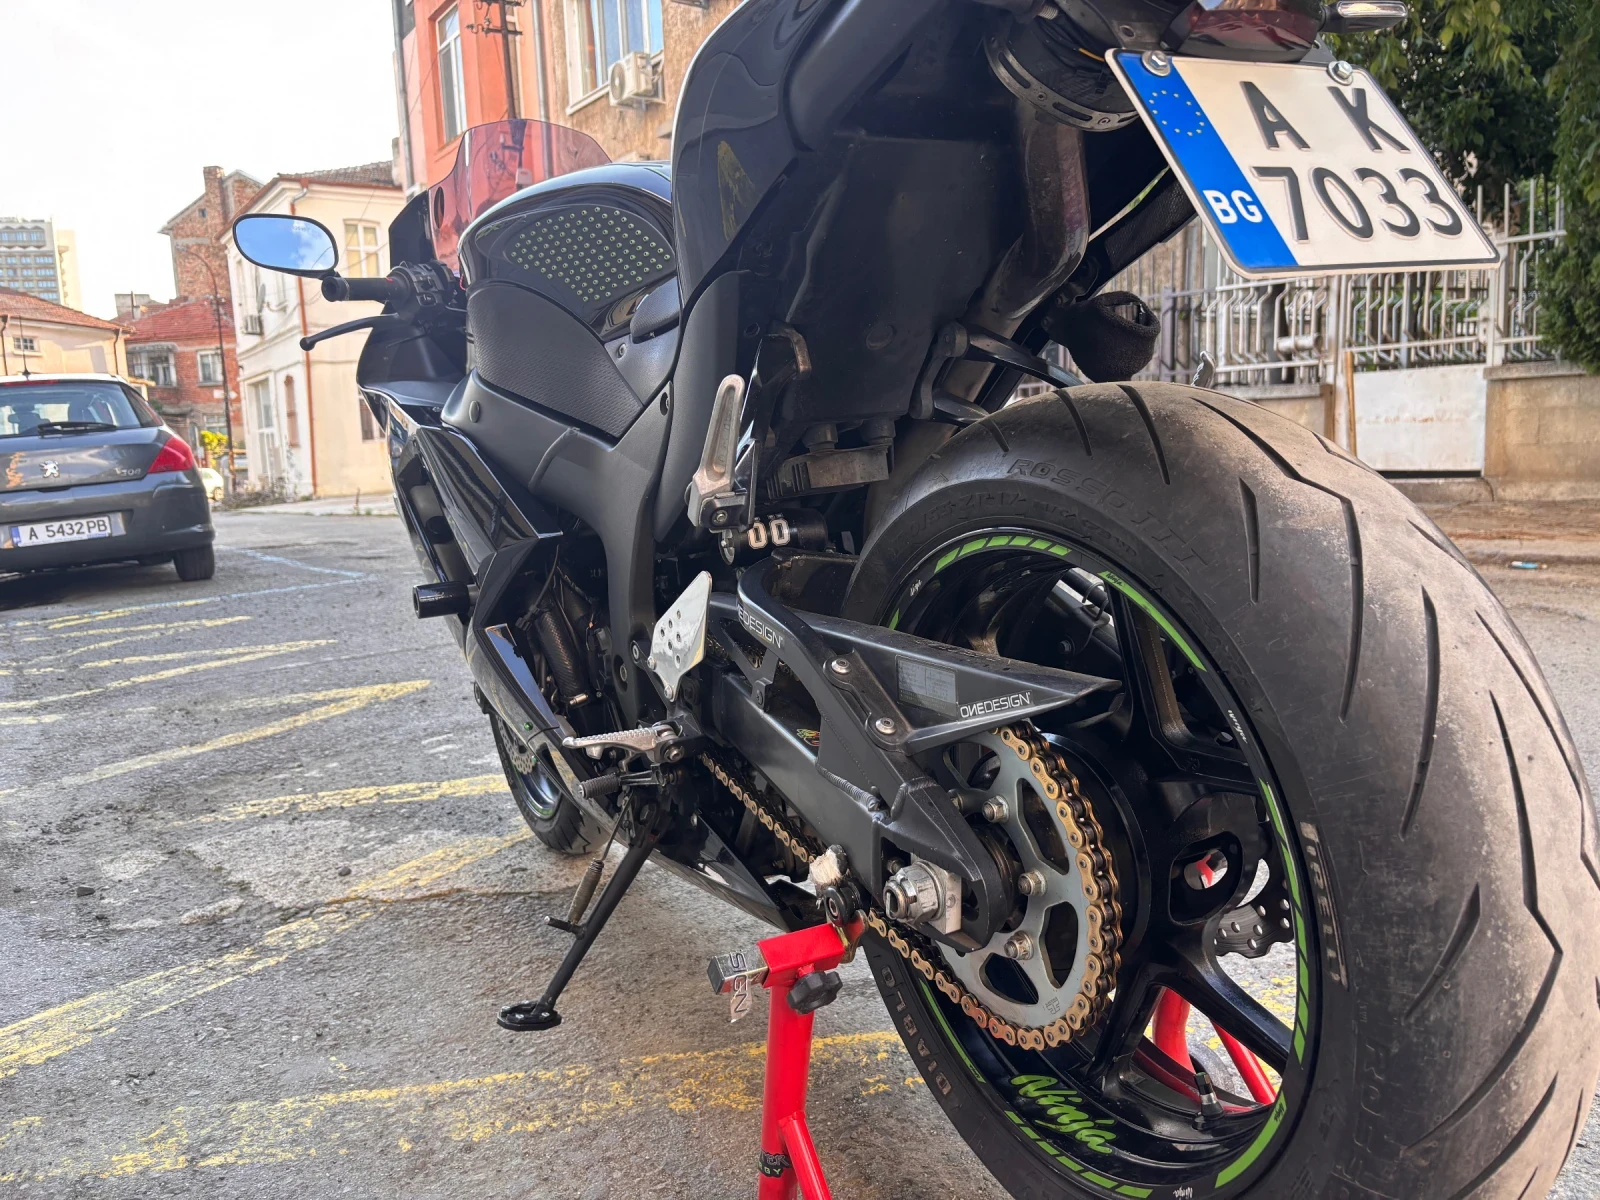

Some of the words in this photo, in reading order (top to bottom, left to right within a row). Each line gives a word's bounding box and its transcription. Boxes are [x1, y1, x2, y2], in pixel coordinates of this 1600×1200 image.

[1239, 80, 1311, 151] A
[1326, 85, 1411, 153] K
[1202, 188, 1264, 224] BG
[1251, 165, 1464, 243] 7033
[28, 526, 39, 541] A
[881, 965, 952, 1096] DIABLO
[1010, 1074, 1117, 1154] Ninja
